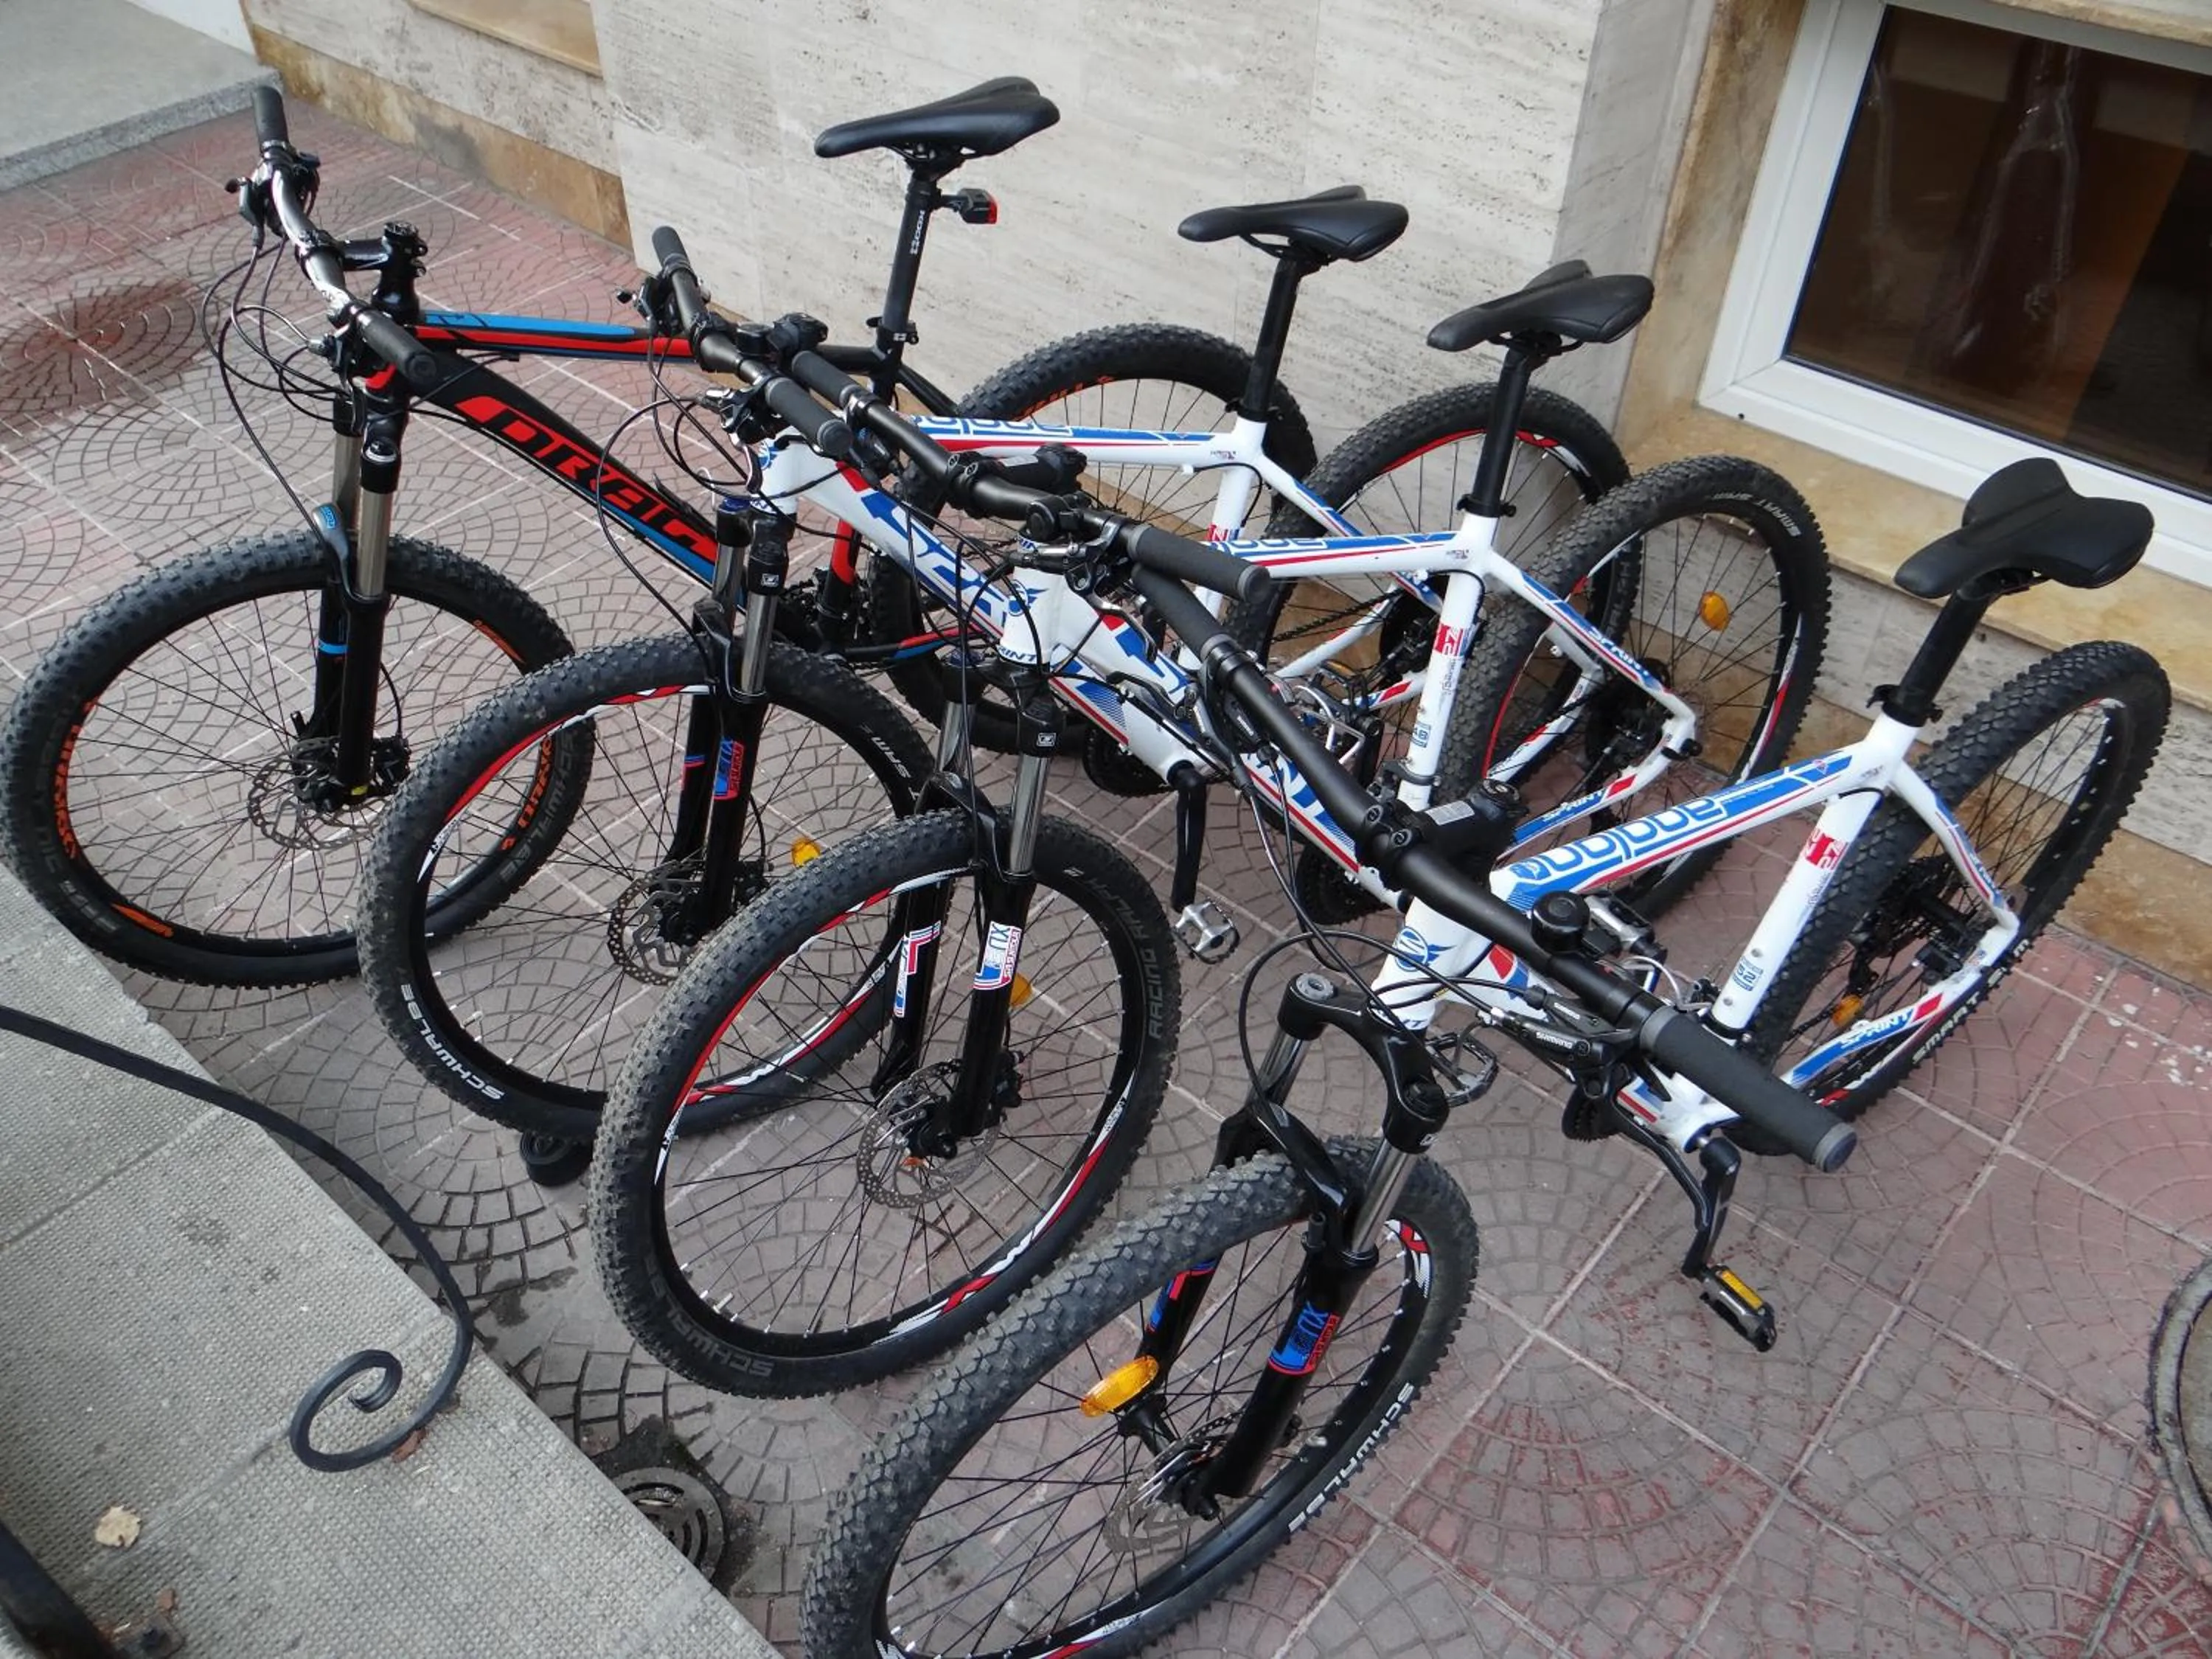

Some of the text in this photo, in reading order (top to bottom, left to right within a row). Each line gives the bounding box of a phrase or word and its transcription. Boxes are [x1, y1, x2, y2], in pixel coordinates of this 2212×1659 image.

[400, 982, 506, 1102] SCHWALBE
[1840, 1007, 1913, 1049] SPRINT
[1289, 1382, 1416, 1532] SCHWALBE
